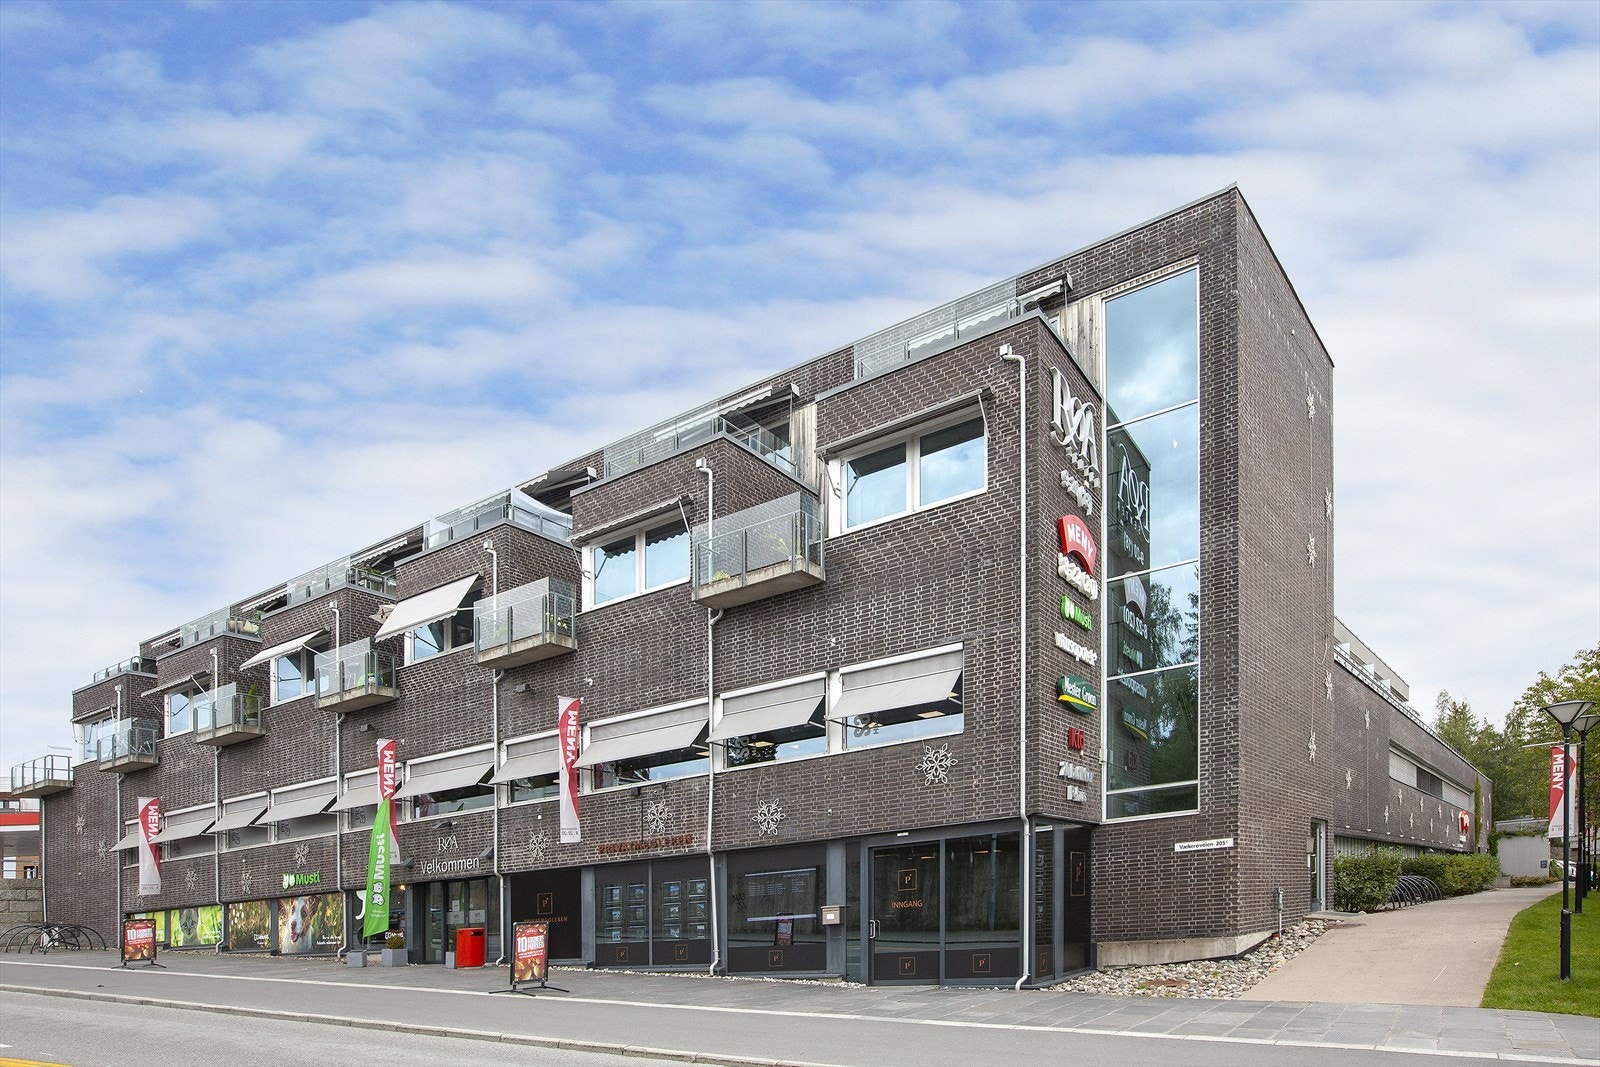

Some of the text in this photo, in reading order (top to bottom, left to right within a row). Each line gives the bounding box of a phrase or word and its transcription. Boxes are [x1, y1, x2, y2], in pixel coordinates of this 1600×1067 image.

[1066, 523, 1093, 559] MENY
[1074, 603, 1092, 630] Musti
[1064, 676, 1082, 696] Mester
[1552, 752, 1564, 790] MENY
[373, 832, 386, 880] Musti
[420, 857, 480, 875] Velkommen
[295, 871, 321, 885] Musti
[891, 899, 923, 909] INNGANG
[127, 929, 137, 941] 10
[517, 936, 528, 953] 10
